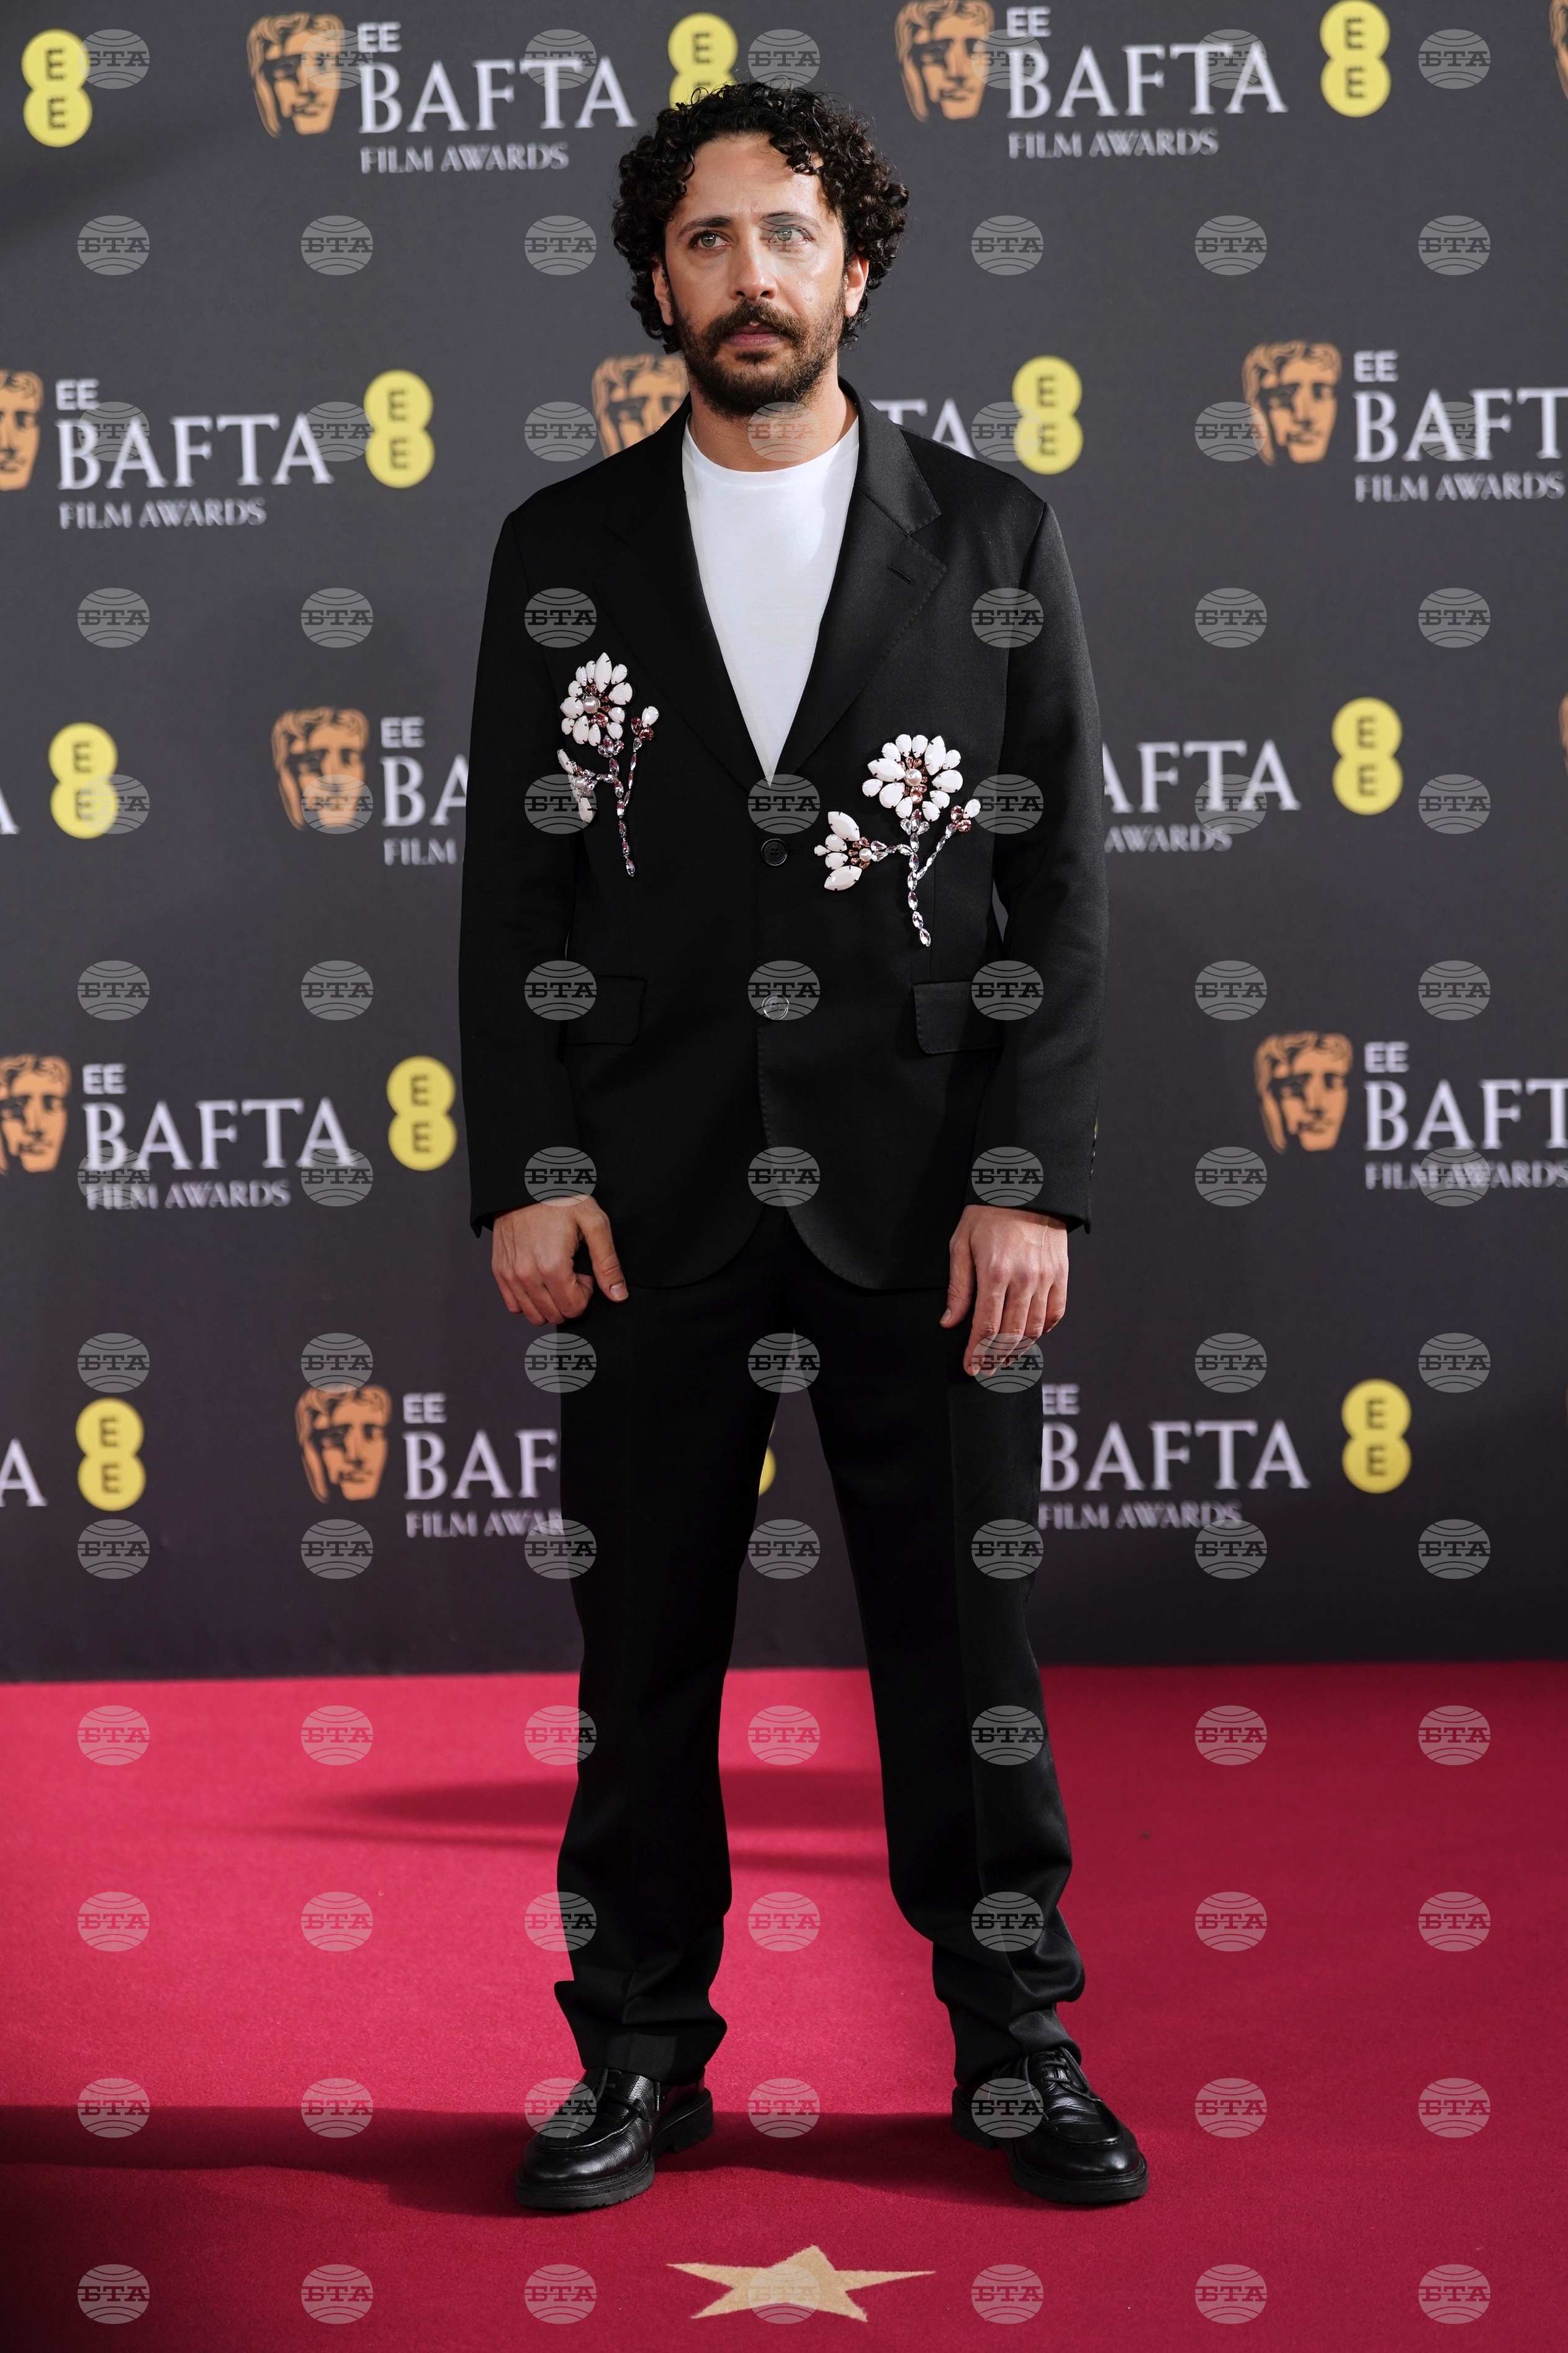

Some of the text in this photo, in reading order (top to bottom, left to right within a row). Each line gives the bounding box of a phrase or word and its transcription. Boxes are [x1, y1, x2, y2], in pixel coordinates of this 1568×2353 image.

[358, 21, 402, 53] EE
[1006, 6, 1051, 37] EE
[356, 55, 638, 133] BAFTA
[1005, 42, 1289, 119] BAFTA
[361, 142, 569, 174] FILM AWARDS
[1008, 127, 1219, 159] FILM AWARDS
[1353, 350, 1399, 382] EE
[55, 378, 99, 410] EE
[55, 412, 335, 490] BAFTA
[1354, 471, 1566, 502] FILM AWARDS
[59, 497, 267, 529] FILM AWARDS
[380, 716, 425, 748] EE
[384, 838, 457, 865] FILM
[1104, 824, 1233, 853] AWARDS
[1364, 1041, 1409, 1073] EE
[82, 1063, 127, 1095] EE
[81, 1097, 356, 1171] BAFTA
[86, 1180, 291, 1210] FILM AWARDS
[403, 1392, 447, 1424] EE
[1042, 1383, 1080, 1415] EE
[1040, 1419, 1310, 1491] BAFTA
[406, 1510, 478, 1538] FILM
[1038, 1500, 1243, 1529] FILM AWARDS
